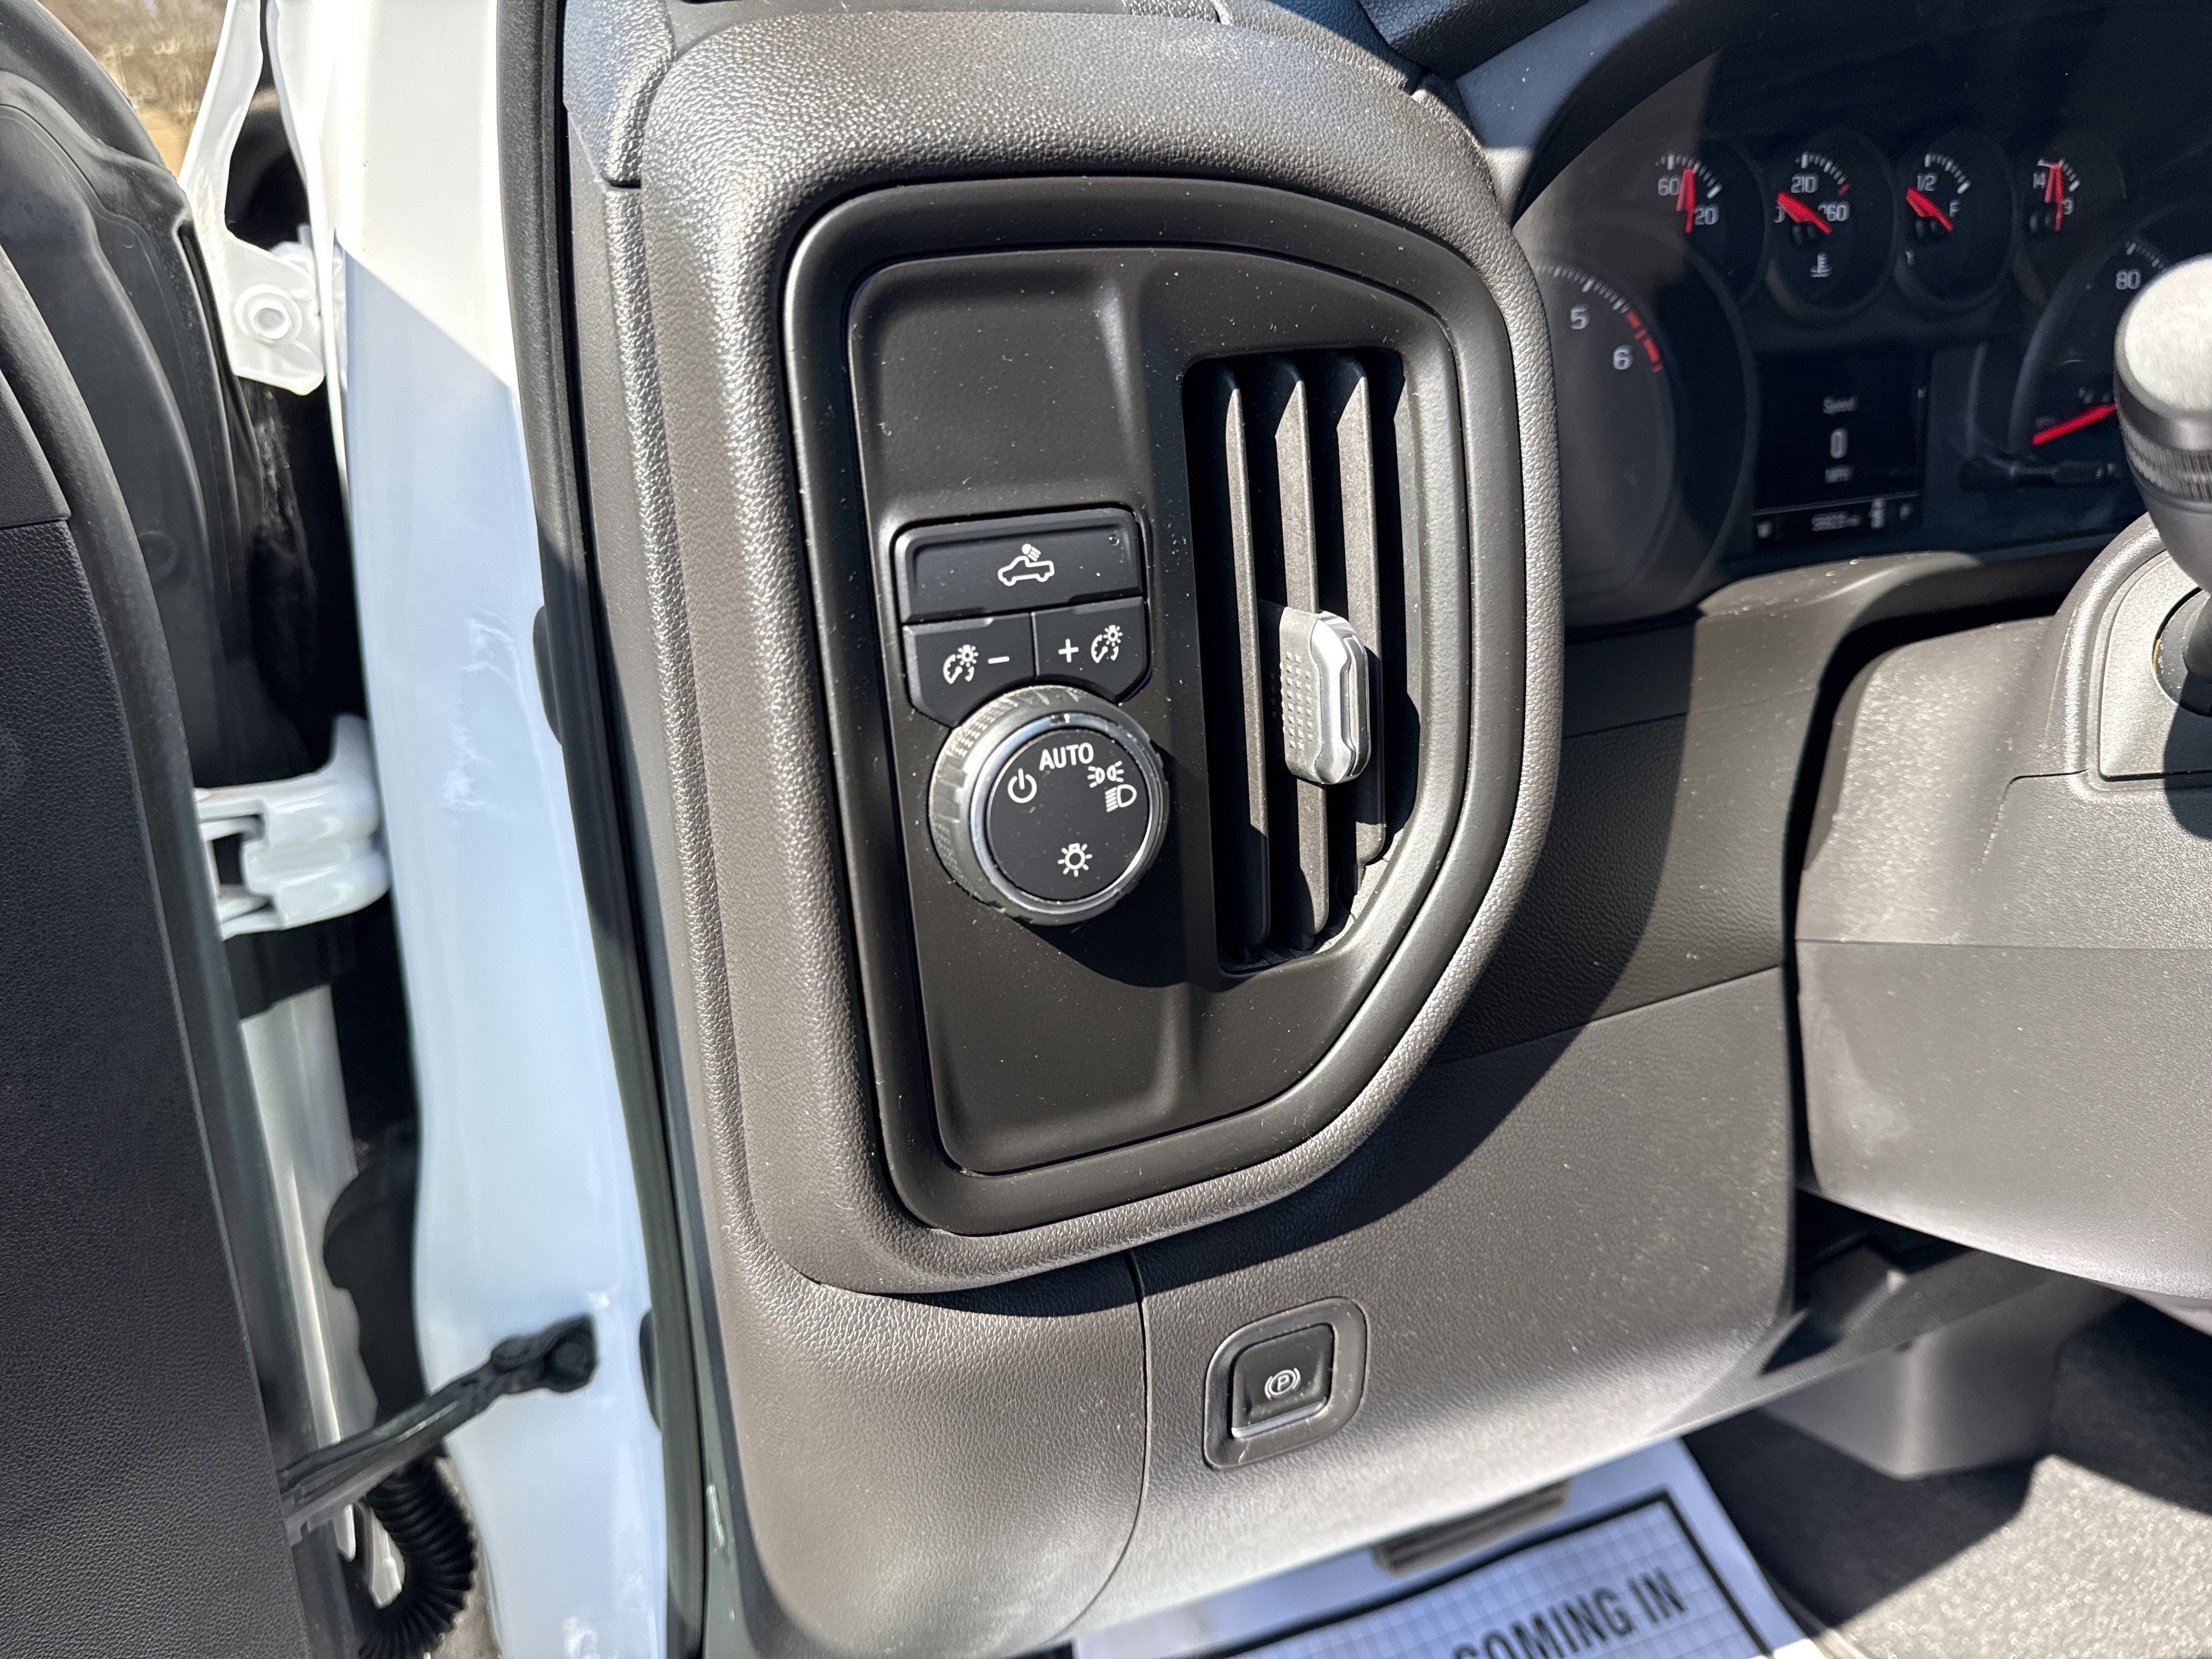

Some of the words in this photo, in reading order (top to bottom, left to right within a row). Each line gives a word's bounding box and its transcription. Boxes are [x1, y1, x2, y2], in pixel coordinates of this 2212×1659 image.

[1657, 175, 1681, 196] 60
[1791, 173, 1819, 193] 210
[2116, 269, 2142, 290] 80
[1570, 304, 1589, 330] 5
[1613, 344, 1633, 370] 6
[1039, 742, 1094, 771] AUTO
[1626, 1567, 1688, 1625] IN
